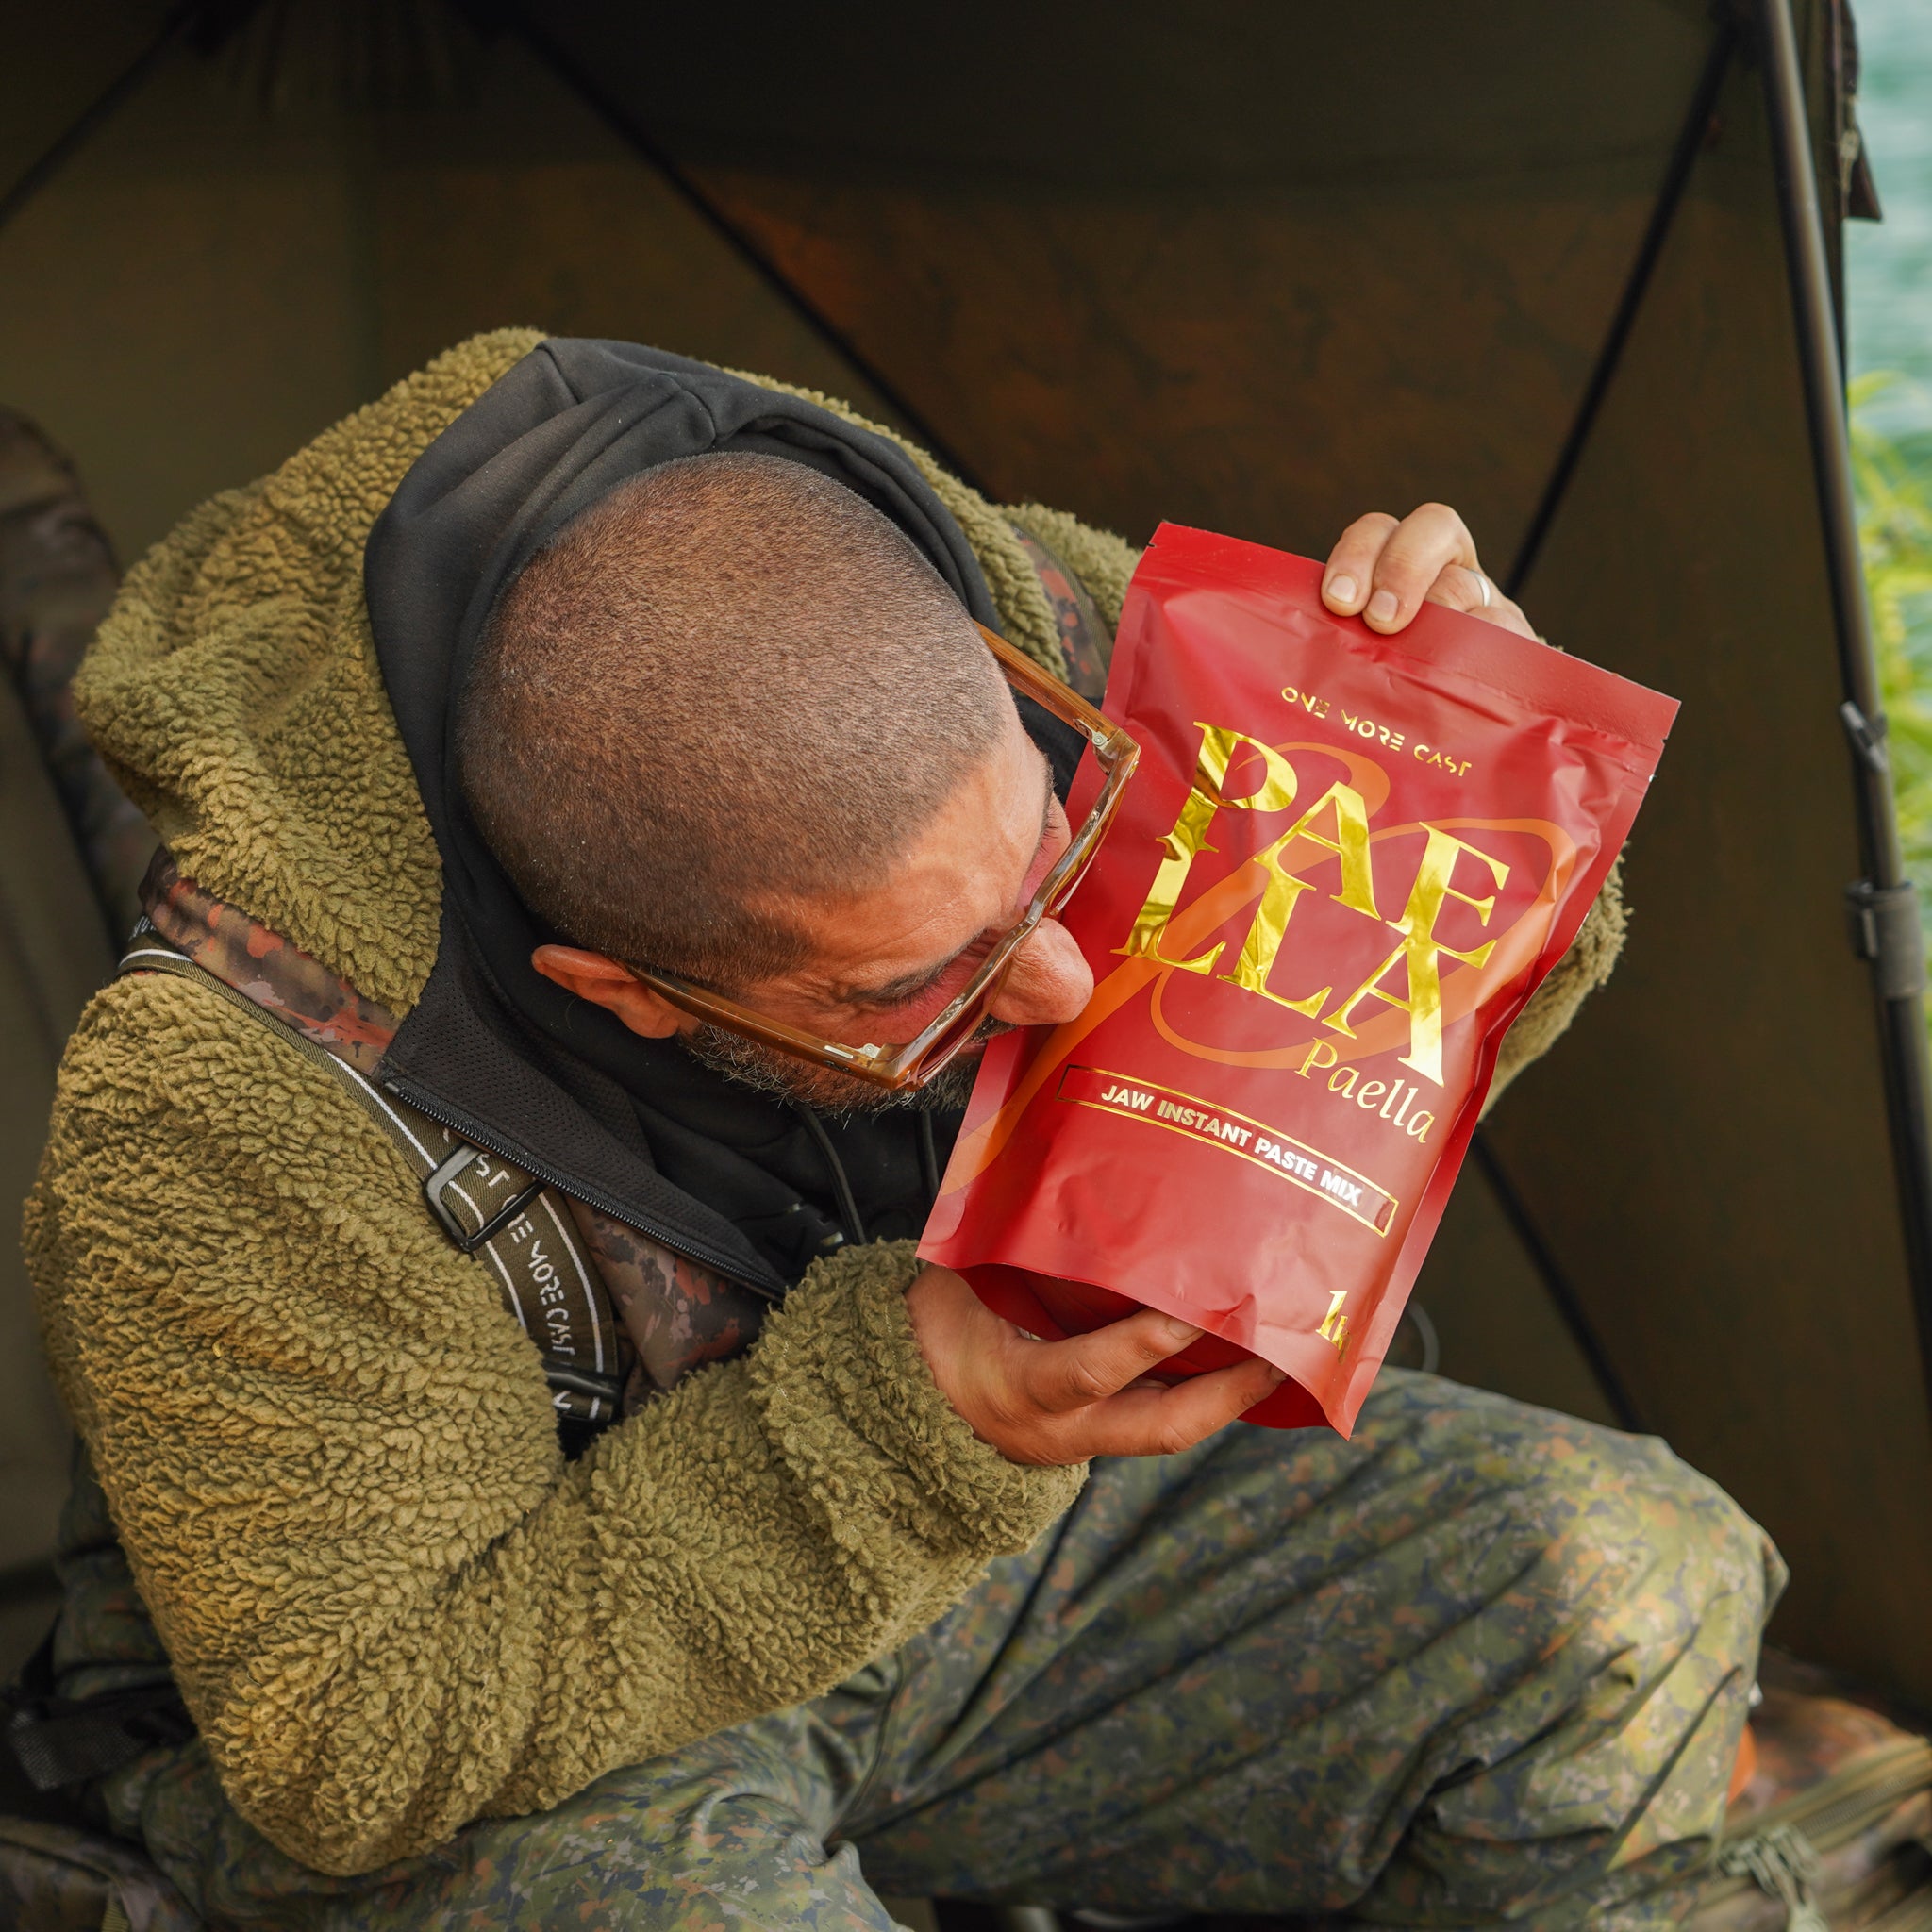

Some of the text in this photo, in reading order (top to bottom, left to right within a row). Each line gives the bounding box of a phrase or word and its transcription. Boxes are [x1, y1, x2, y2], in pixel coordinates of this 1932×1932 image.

[1281, 686, 1472, 776] ONE MORE CAST
[1293, 1036, 1435, 1143] Paella
[1101, 1085, 1362, 1207] JAW INSTANT PASTE MIX
[528, 1240, 564, 1306] MORE
[546, 1307, 575, 1356] CAST
